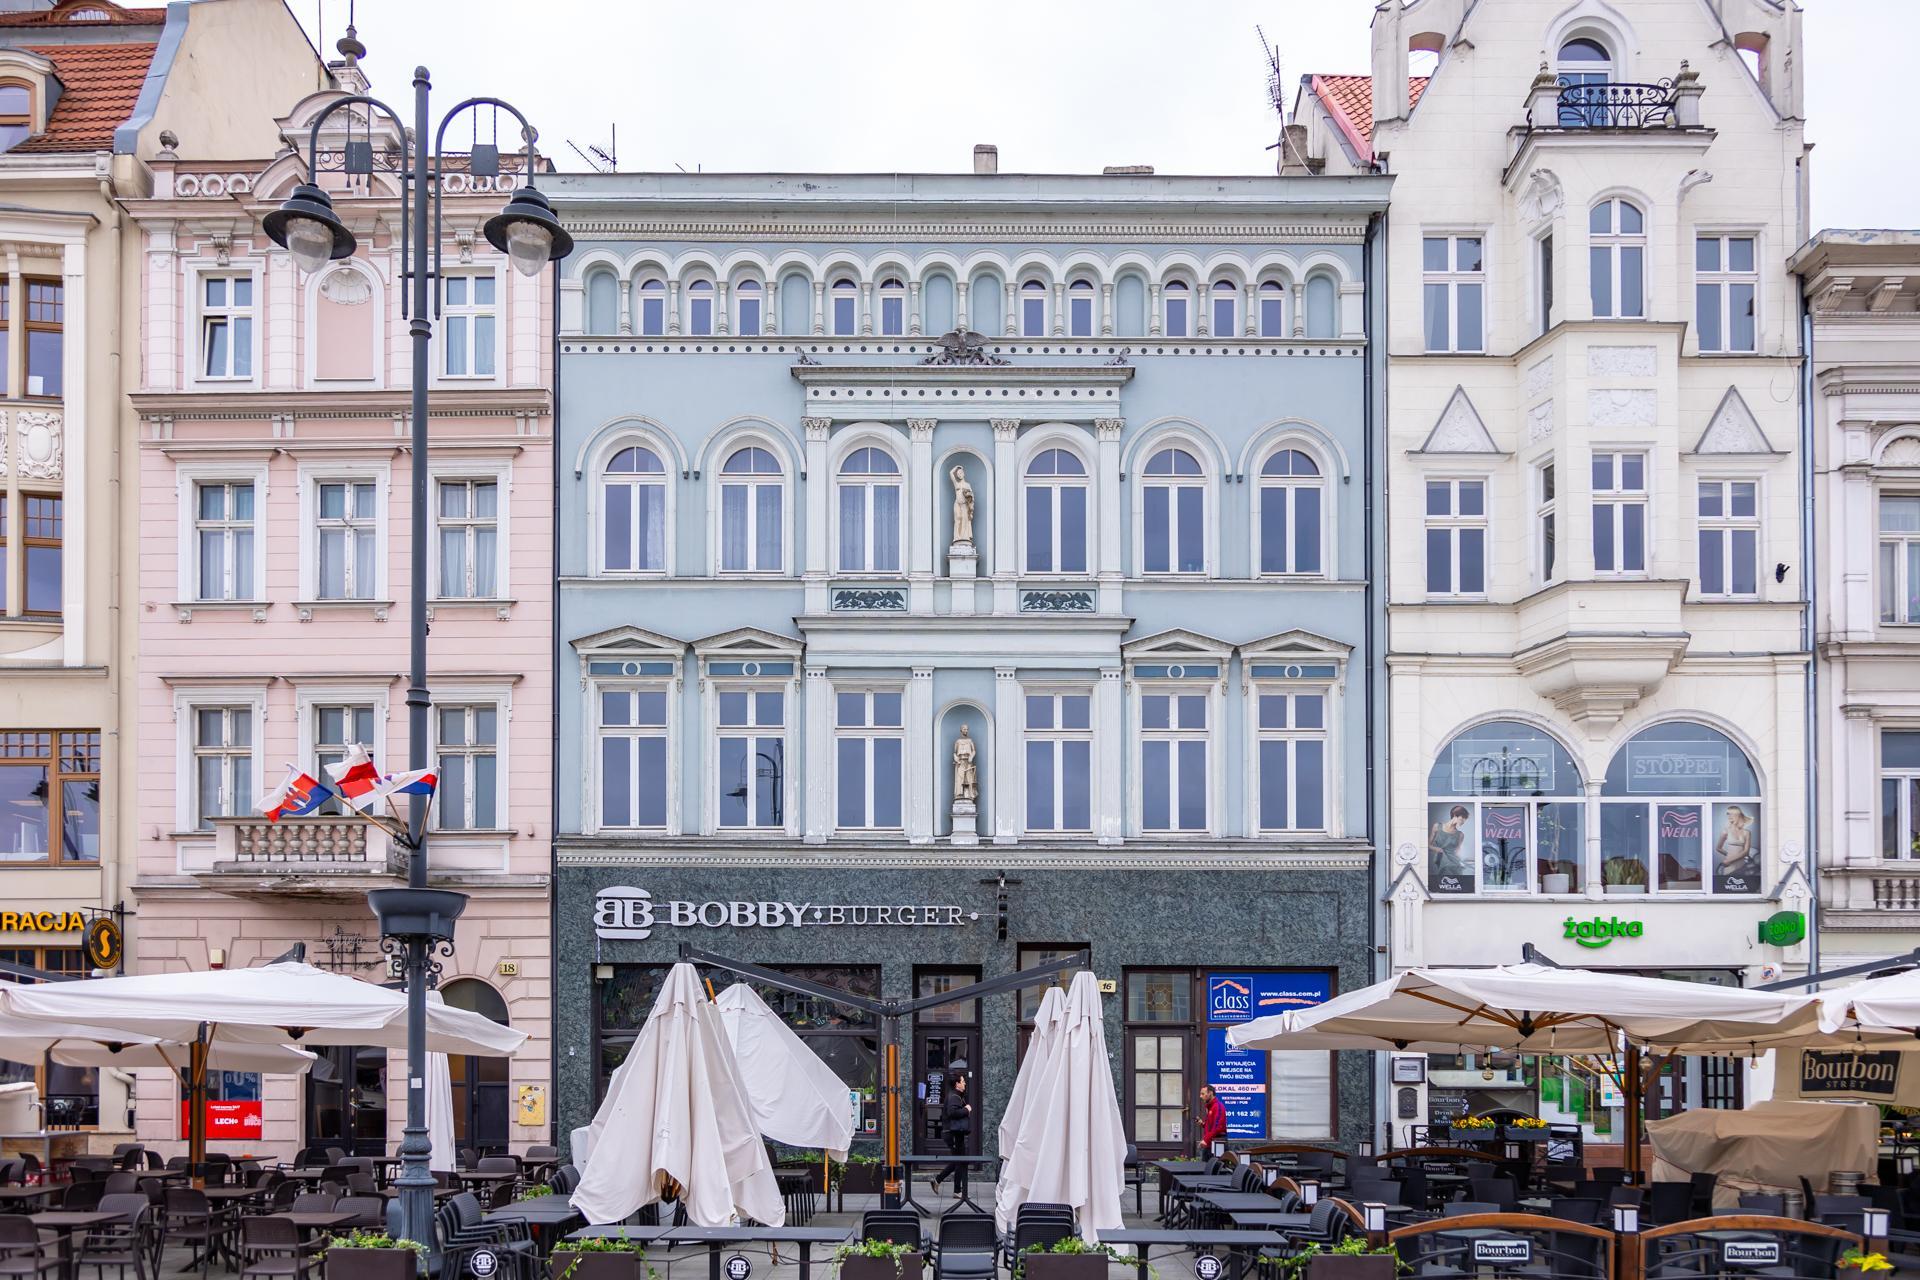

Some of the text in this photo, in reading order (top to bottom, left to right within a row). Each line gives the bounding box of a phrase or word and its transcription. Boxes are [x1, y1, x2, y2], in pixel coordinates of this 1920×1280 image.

[1635, 759, 1720, 774] STOPPEL
[1485, 828, 1521, 839] WELLA
[1661, 827, 1699, 838] WELLA
[669, 900, 811, 927] BOBBY
[828, 905, 965, 926] BURGER
[1563, 916, 1643, 939] żabka
[1769, 919, 1797, 936] żabka
[503, 964, 515, 973] 18
[1215, 987, 1249, 1009] class
[1803, 1053, 1895, 1081] Bourbon
[1478, 1245, 1526, 1254] Bourbon
[1728, 1247, 1775, 1257] Bourbon
